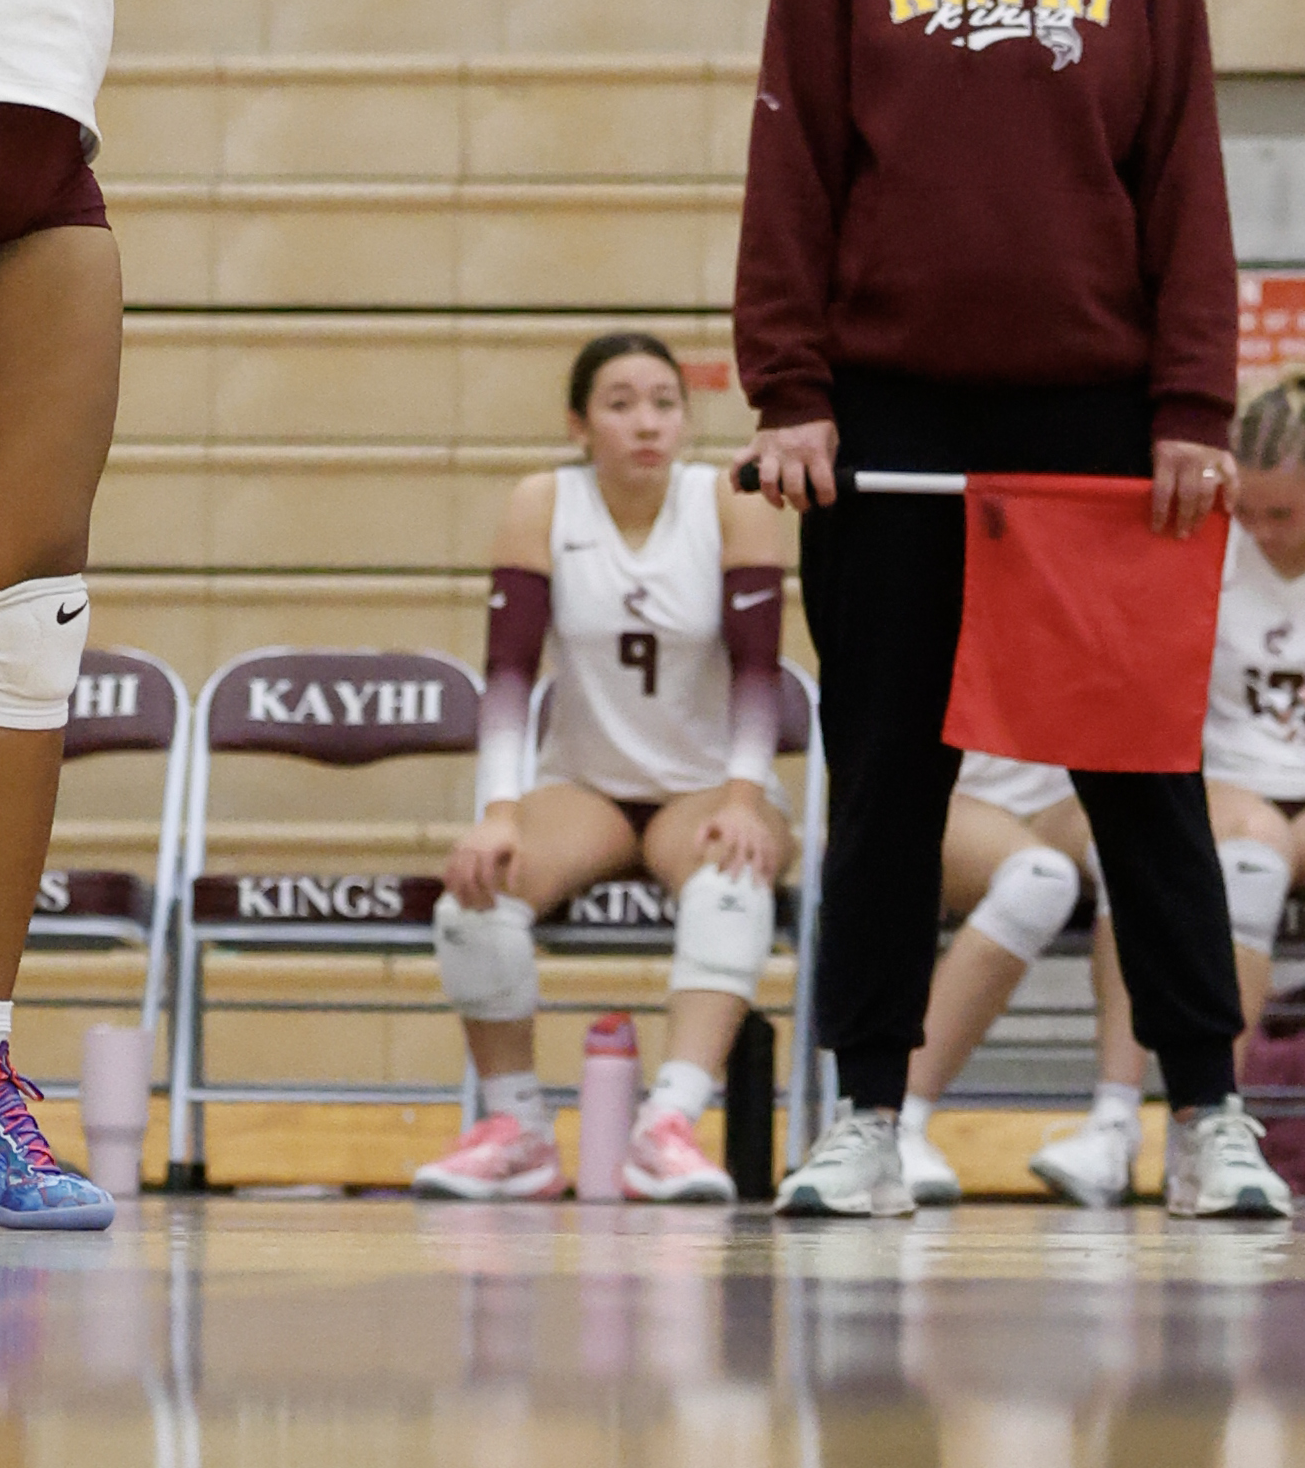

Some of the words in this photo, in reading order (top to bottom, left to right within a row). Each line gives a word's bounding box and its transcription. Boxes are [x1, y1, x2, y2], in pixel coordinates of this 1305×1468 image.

[619, 632, 658, 696] 9
[249, 677, 443, 726] KAYHI
[238, 875, 404, 918] KINGS
